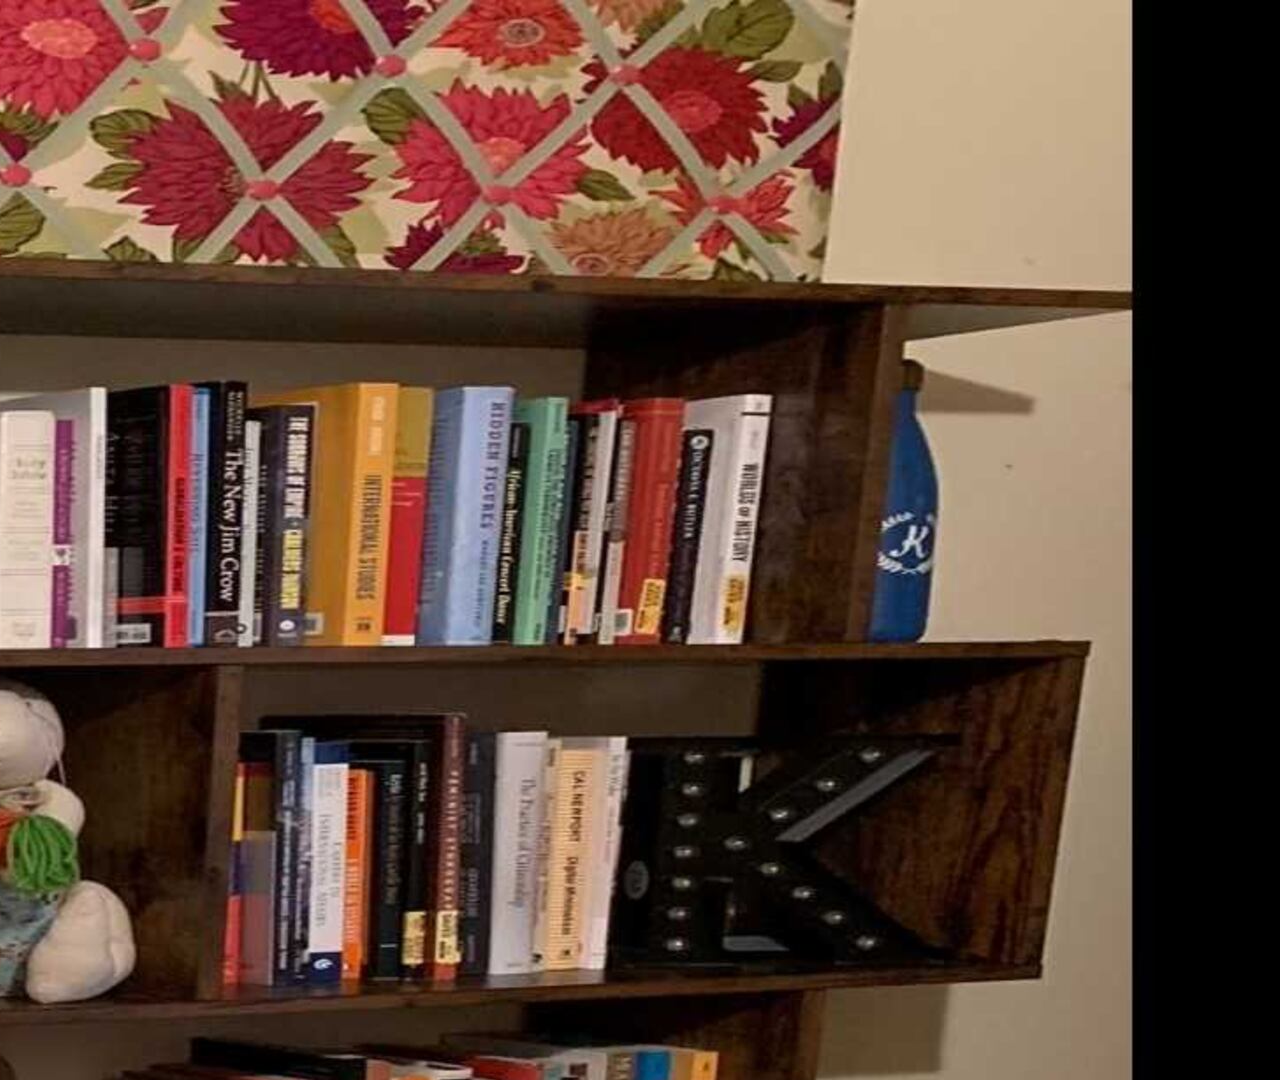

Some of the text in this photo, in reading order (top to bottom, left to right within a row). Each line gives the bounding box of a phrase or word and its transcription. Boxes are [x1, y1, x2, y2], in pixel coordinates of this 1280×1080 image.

[287, 416, 309, 432] THE
[479, 401, 507, 530] HIDDEN FIGURES
[738, 462, 760, 505] WORLDS
[218, 449, 243, 602] The New Jim Crow
[358, 474, 383, 555] INTERNATIONAL
[730, 519, 752, 564] HISTORY
[893, 524, 930, 563] K
[355, 557, 378, 602] STUDIES
[520, 777, 537, 796] The
[572, 770, 586, 790] CAL
[516, 798, 534, 840] Practice
[568, 793, 584, 844] NEWPORT
[516, 841, 532, 852] of
[563, 856, 580, 885] Digital
